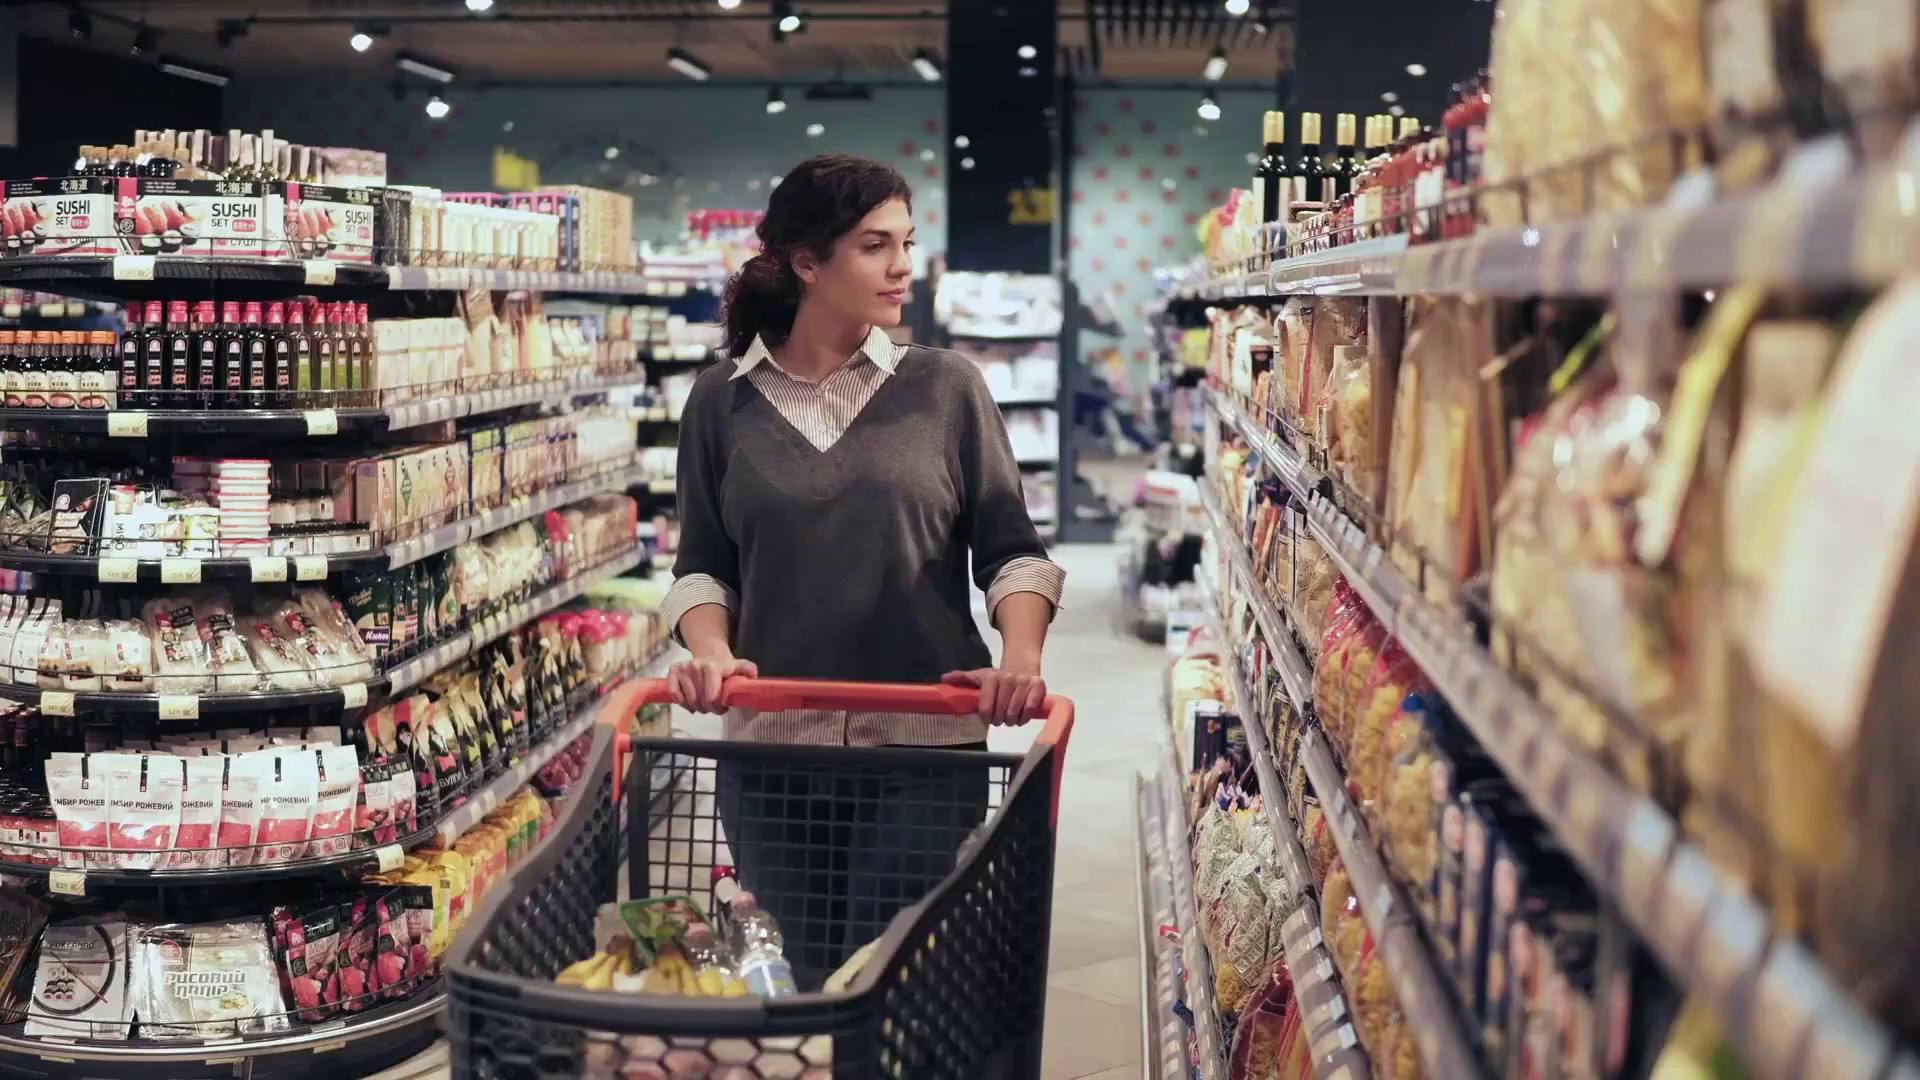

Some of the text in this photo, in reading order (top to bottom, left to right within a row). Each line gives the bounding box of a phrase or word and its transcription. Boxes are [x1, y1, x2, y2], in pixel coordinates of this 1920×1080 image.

[215, 182, 253, 194] 北海道
[56, 200, 90, 215] SUSHI
[211, 203, 257, 218] SUSHI
[55, 217, 69, 226] SET
[345, 210, 371, 225] SUSHI
[211, 219, 229, 227] SET
[345, 224, 356, 233] SET
[318, 785, 351, 798] РОЖЕВИЙ
[79, 799, 105, 807] РОЖЕВ
[181, 800, 213, 808] ОЖЕВИЙ
[222, 800, 253, 809] ОЖЕВИЙ
[272, 796, 310, 804] РОЖЕВИЙ
[136, 801, 173, 811] РОЖЕВИЙ
